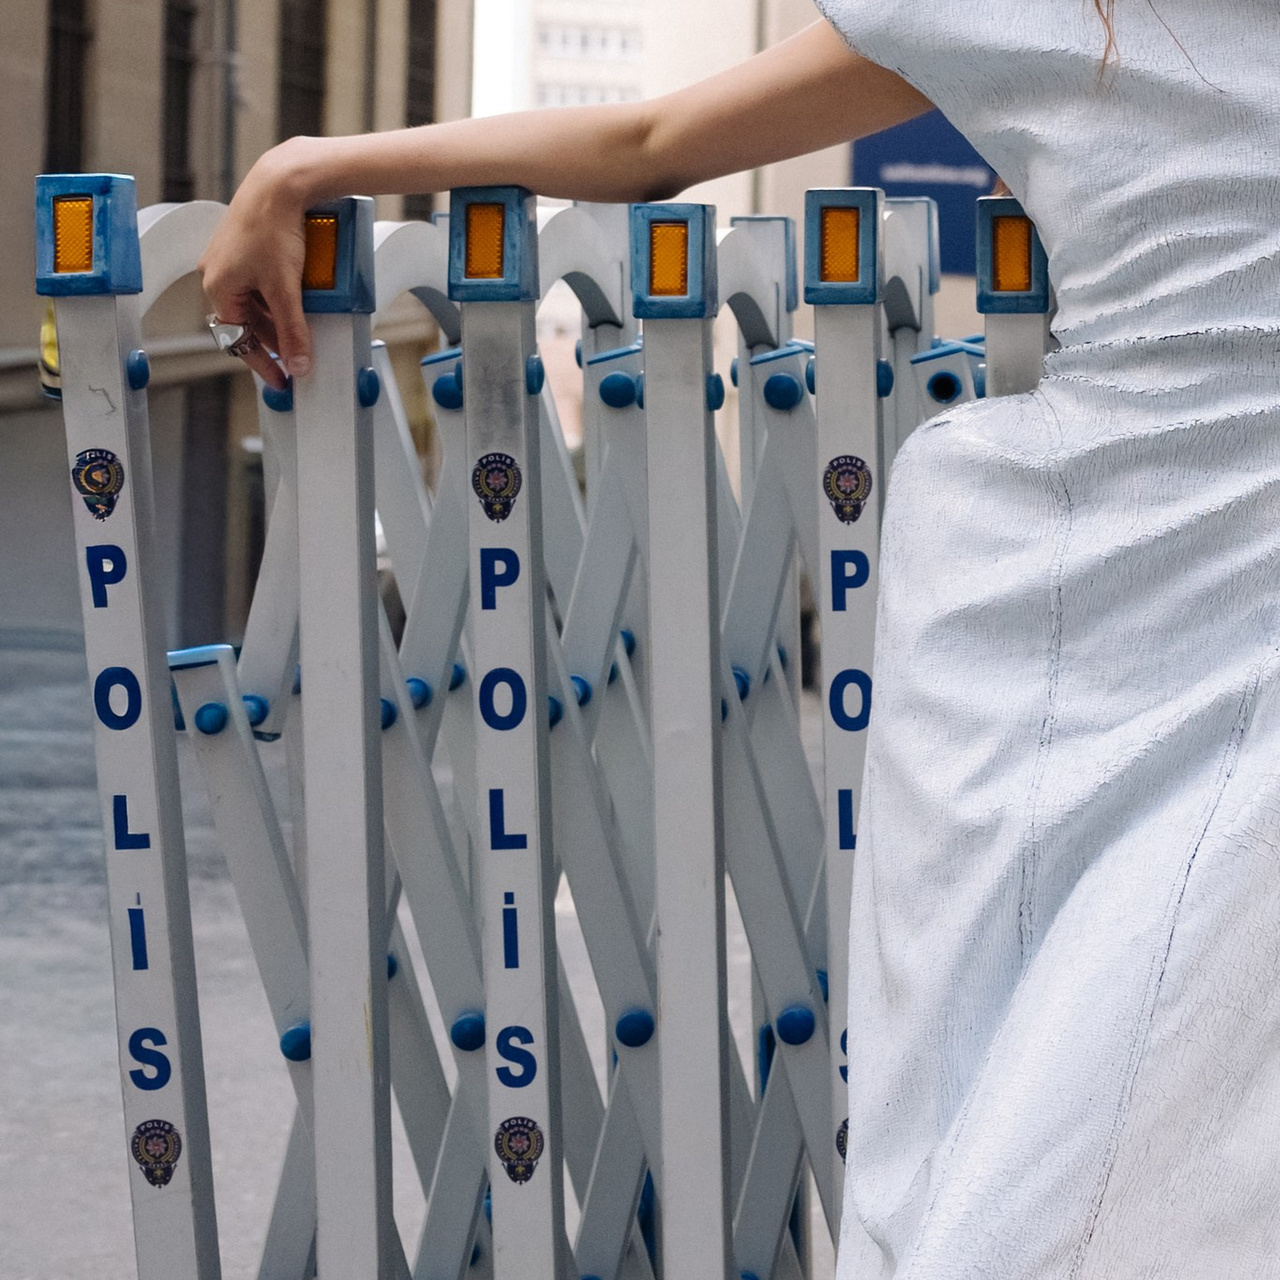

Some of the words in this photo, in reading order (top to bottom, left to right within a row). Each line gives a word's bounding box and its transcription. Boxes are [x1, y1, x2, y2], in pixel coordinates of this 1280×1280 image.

[86, 546, 170, 1090] POLİS
[480, 549, 536, 1087] POLİS
[830, 550, 874, 1086] POL
